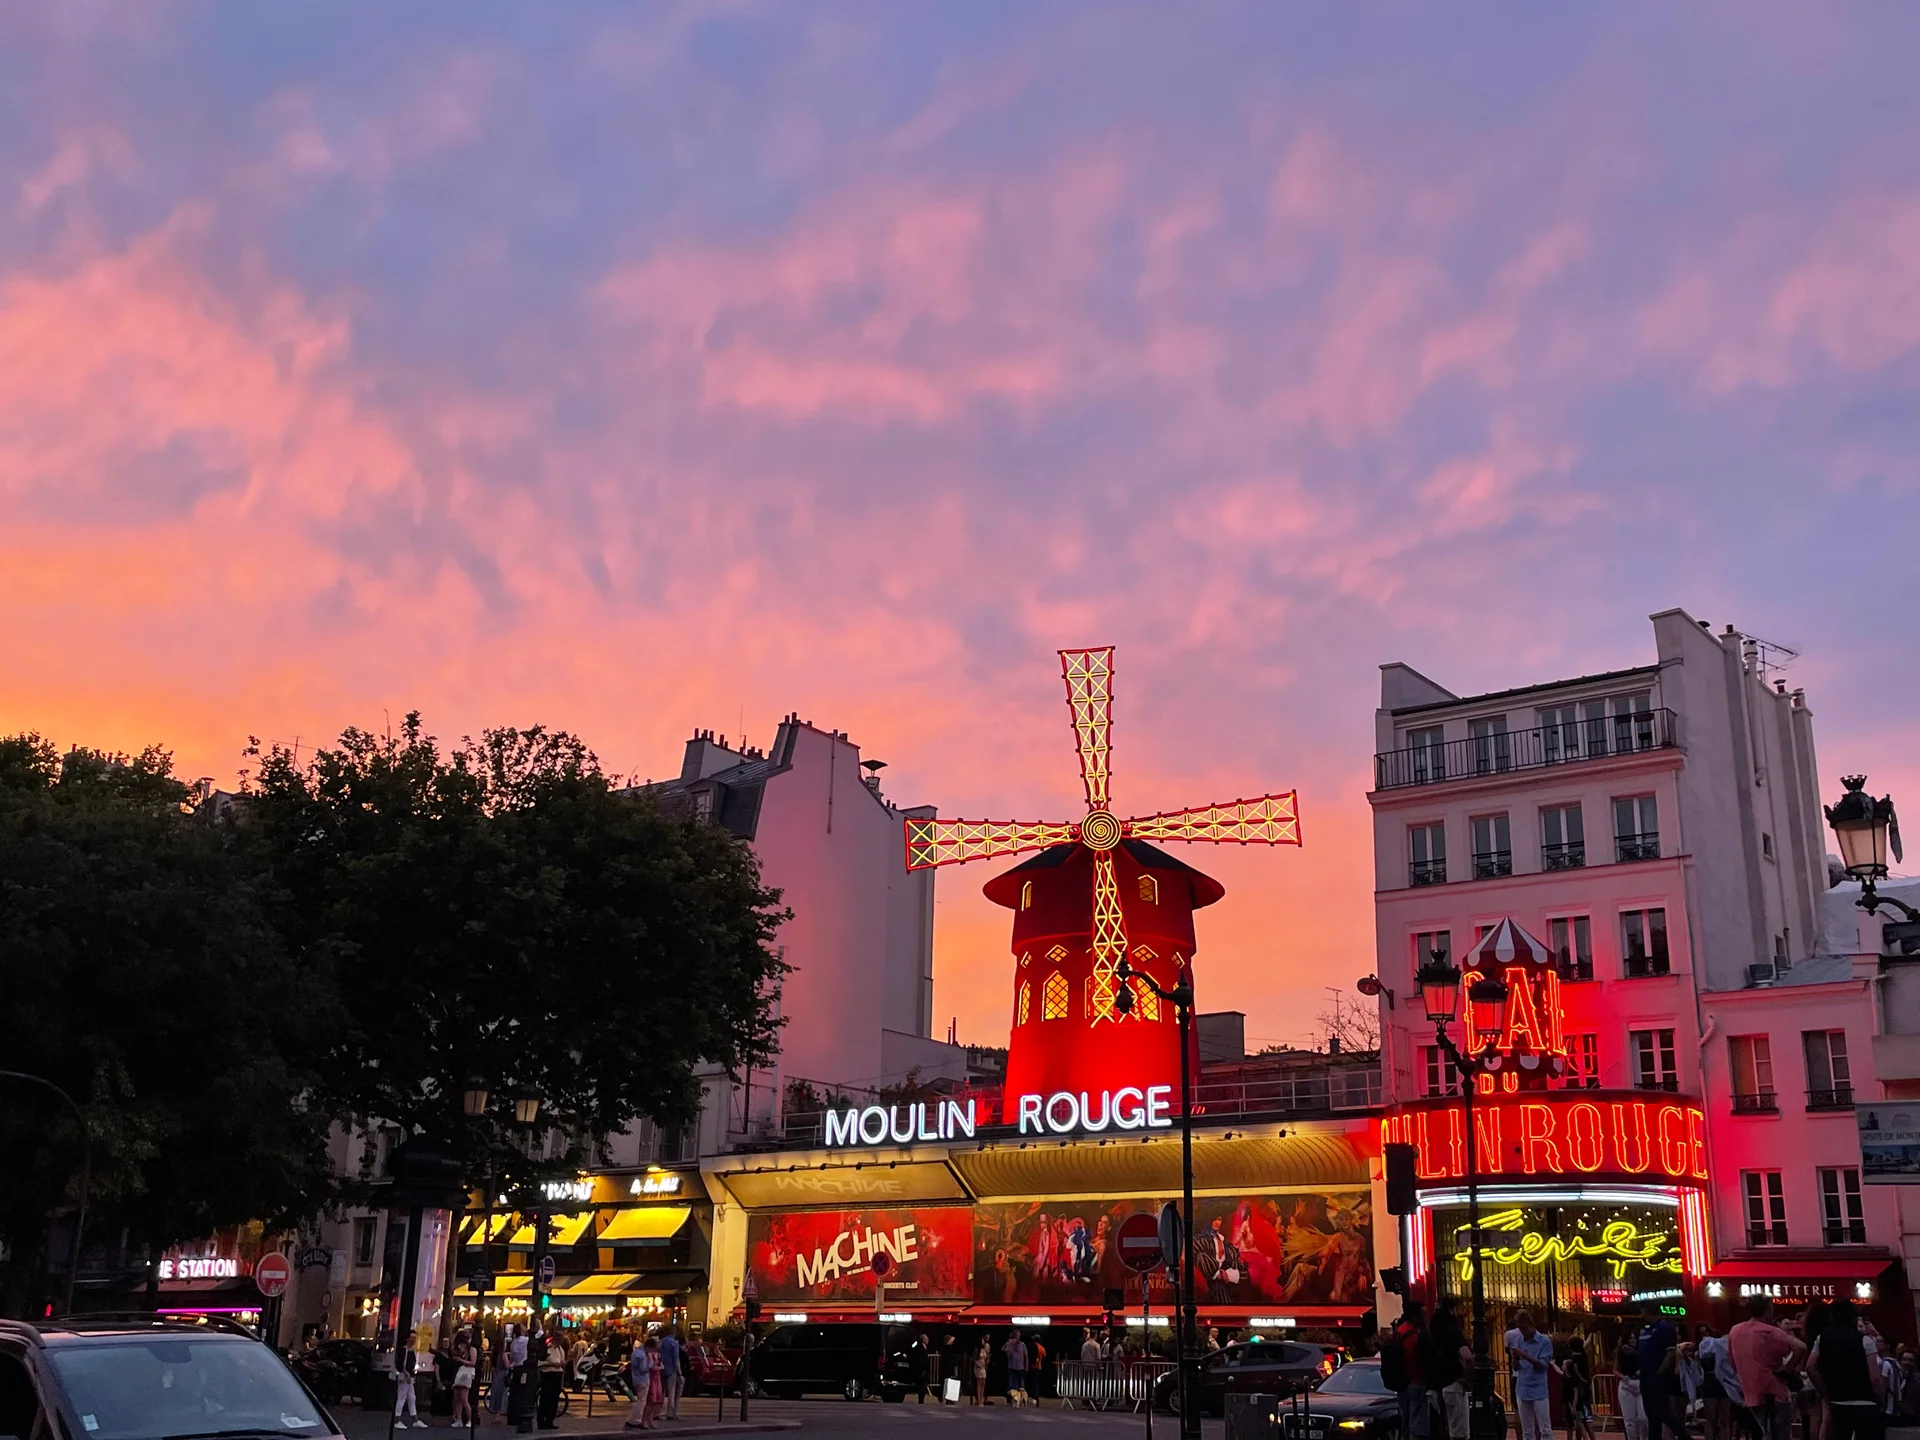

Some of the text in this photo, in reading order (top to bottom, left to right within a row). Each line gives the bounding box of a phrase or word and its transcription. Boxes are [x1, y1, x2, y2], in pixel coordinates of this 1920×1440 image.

[1479, 1072, 1519, 1094] DU
[825, 1086, 1173, 1147] MOULIN ROUGE
[1520, 1103, 1708, 1180] ROUGE
[178, 1258, 238, 1279] STATION
[796, 1224, 918, 1288] MACHINE
[1740, 1283, 1836, 1297] BILLETTERIE
